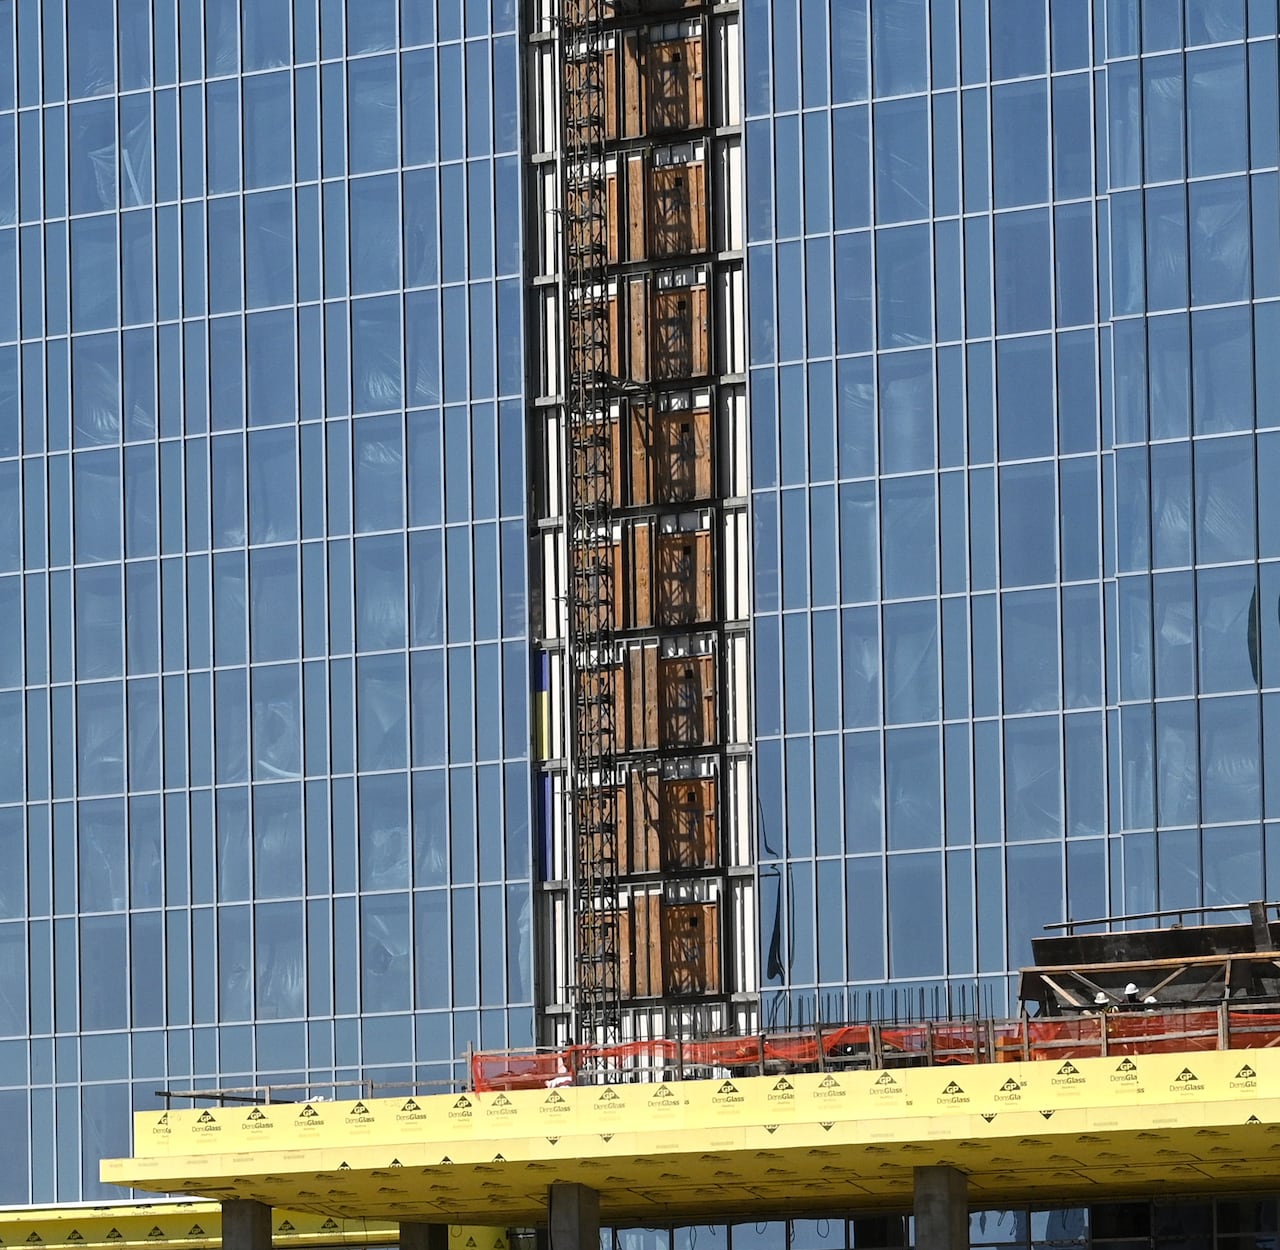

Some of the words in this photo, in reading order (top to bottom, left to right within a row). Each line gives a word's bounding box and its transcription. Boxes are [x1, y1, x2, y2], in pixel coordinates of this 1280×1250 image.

[1051, 1077, 1087, 1086] DensGlass
[1170, 1084, 1204, 1092] DensGlass
[712, 1096, 744, 1104] DensGlass
[937, 1096, 970, 1104] DensGlass
[294, 1119, 324, 1127] DensGlass
